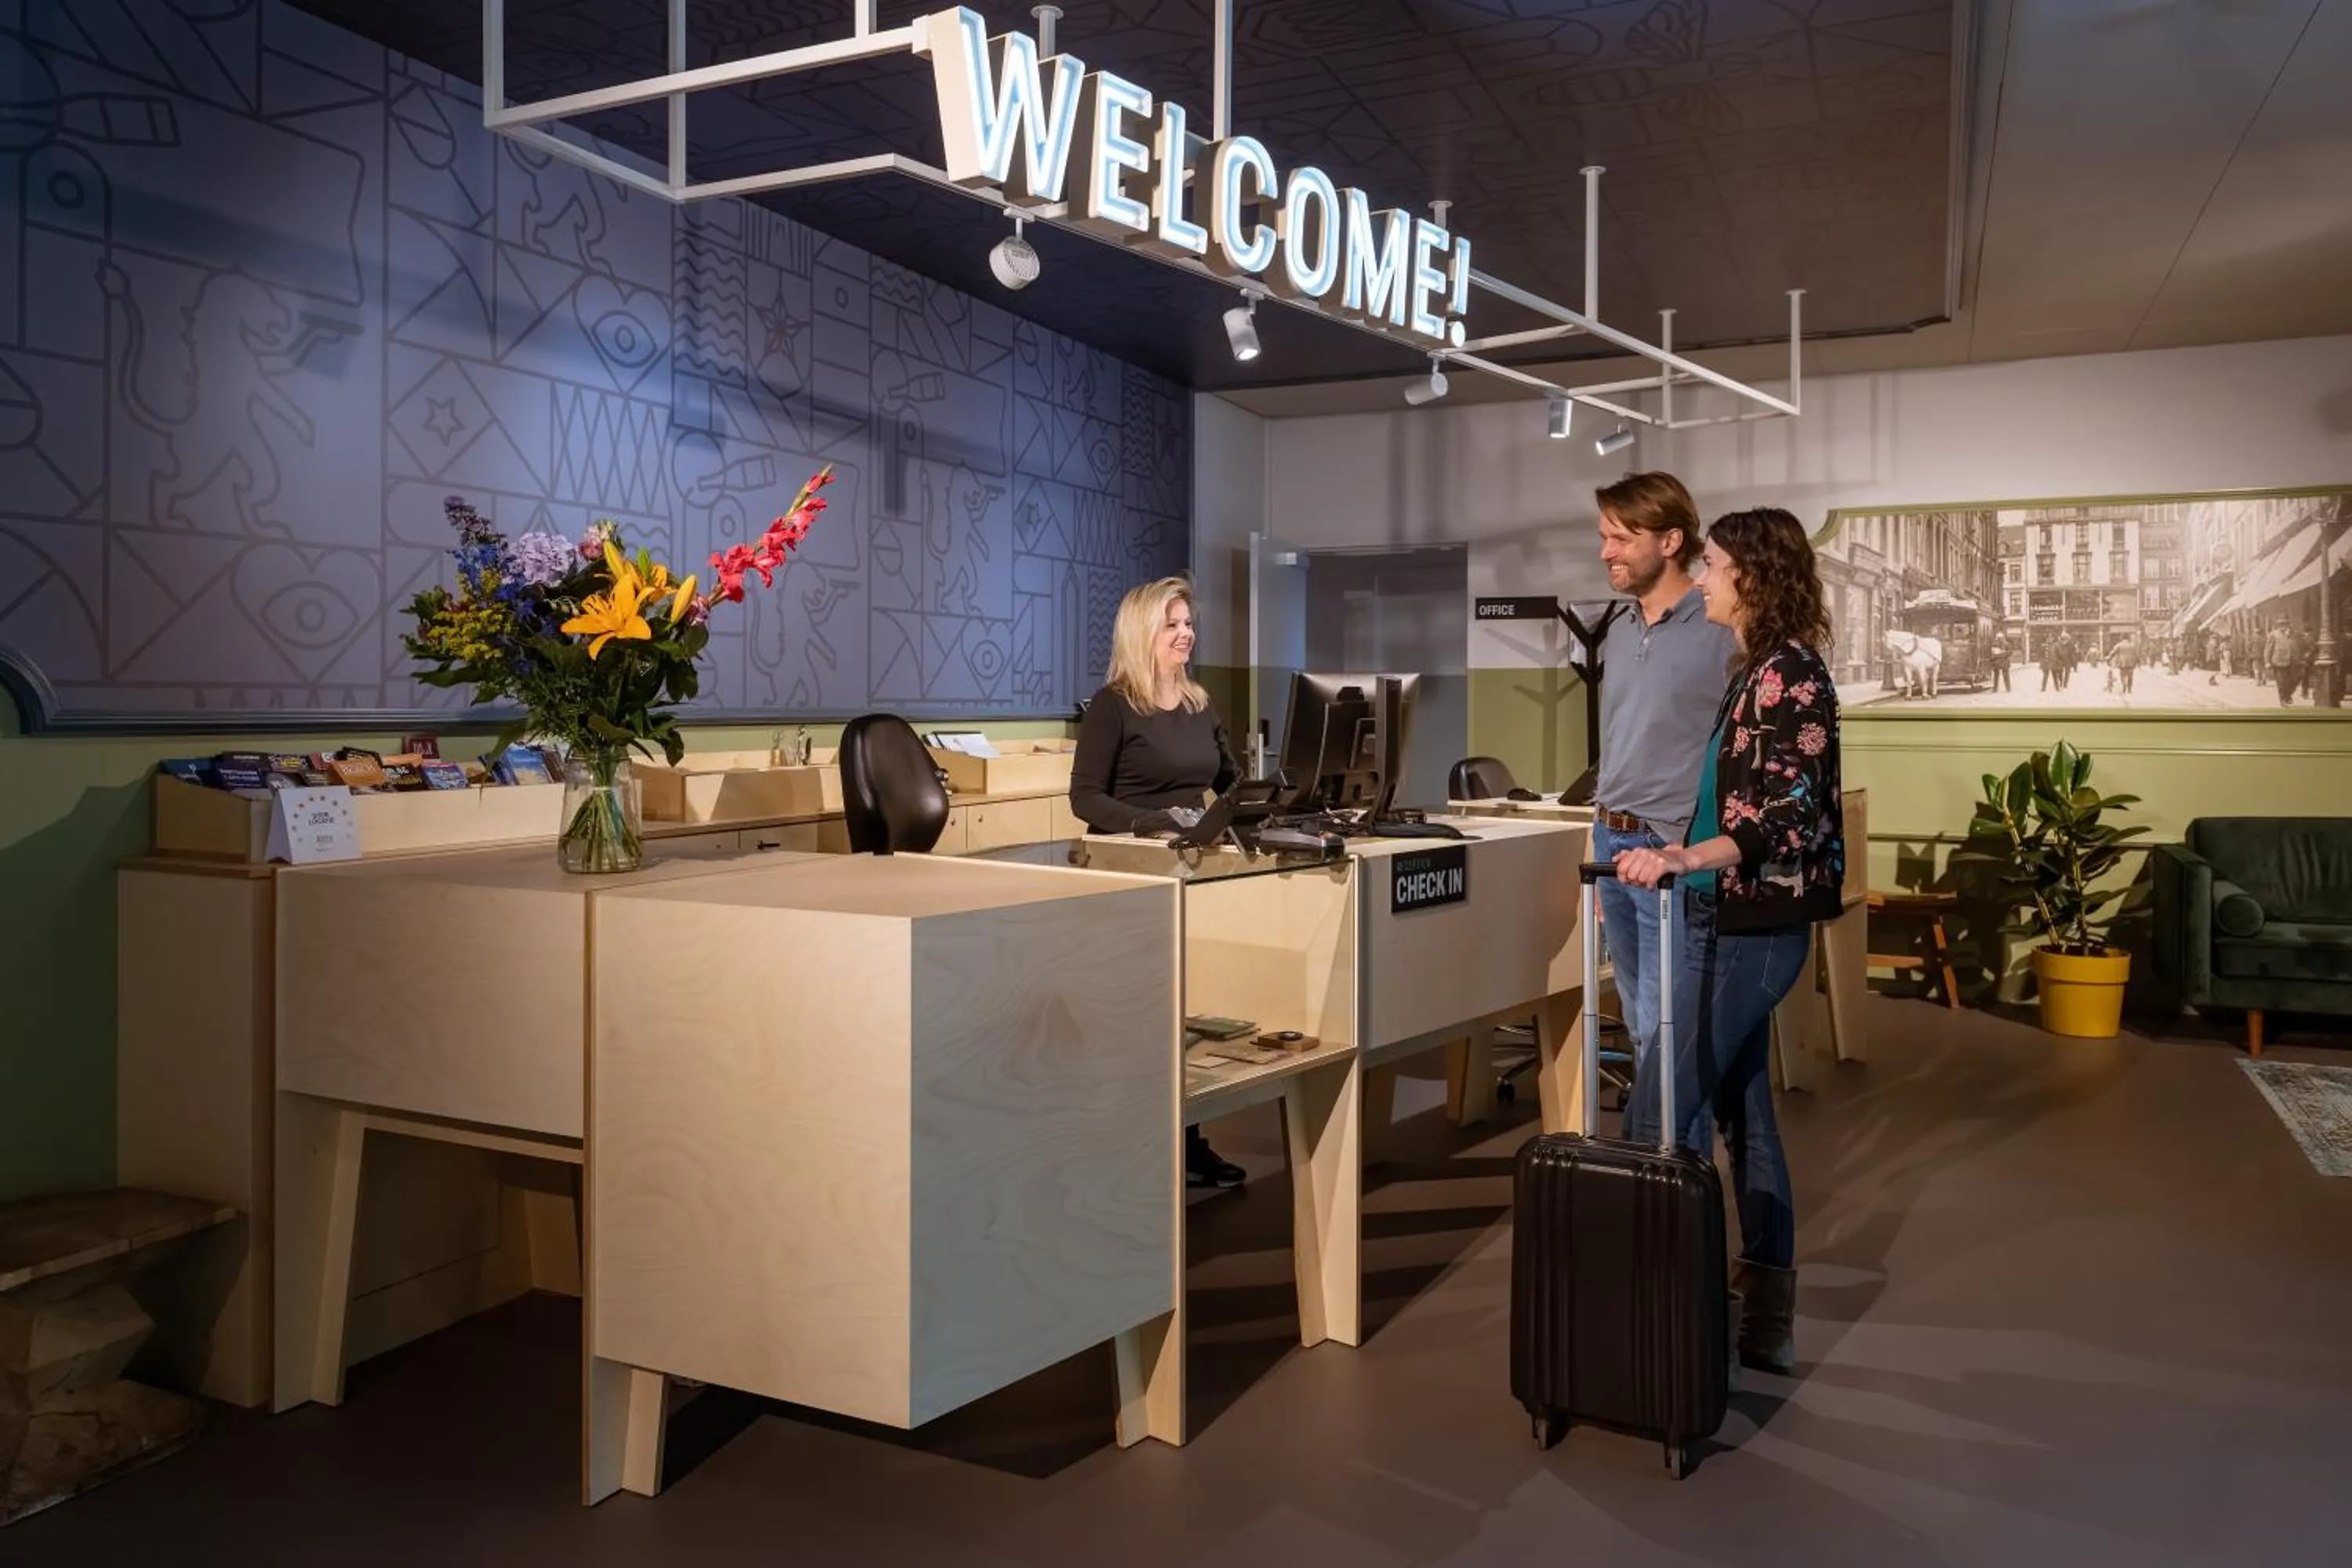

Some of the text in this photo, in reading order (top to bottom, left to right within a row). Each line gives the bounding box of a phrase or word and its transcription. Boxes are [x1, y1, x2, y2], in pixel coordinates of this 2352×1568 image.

[930, 5, 1472, 348] WELCOME!
[1479, 604, 1516, 616] OFFICE
[1396, 867, 1462, 903] CHECK IN
